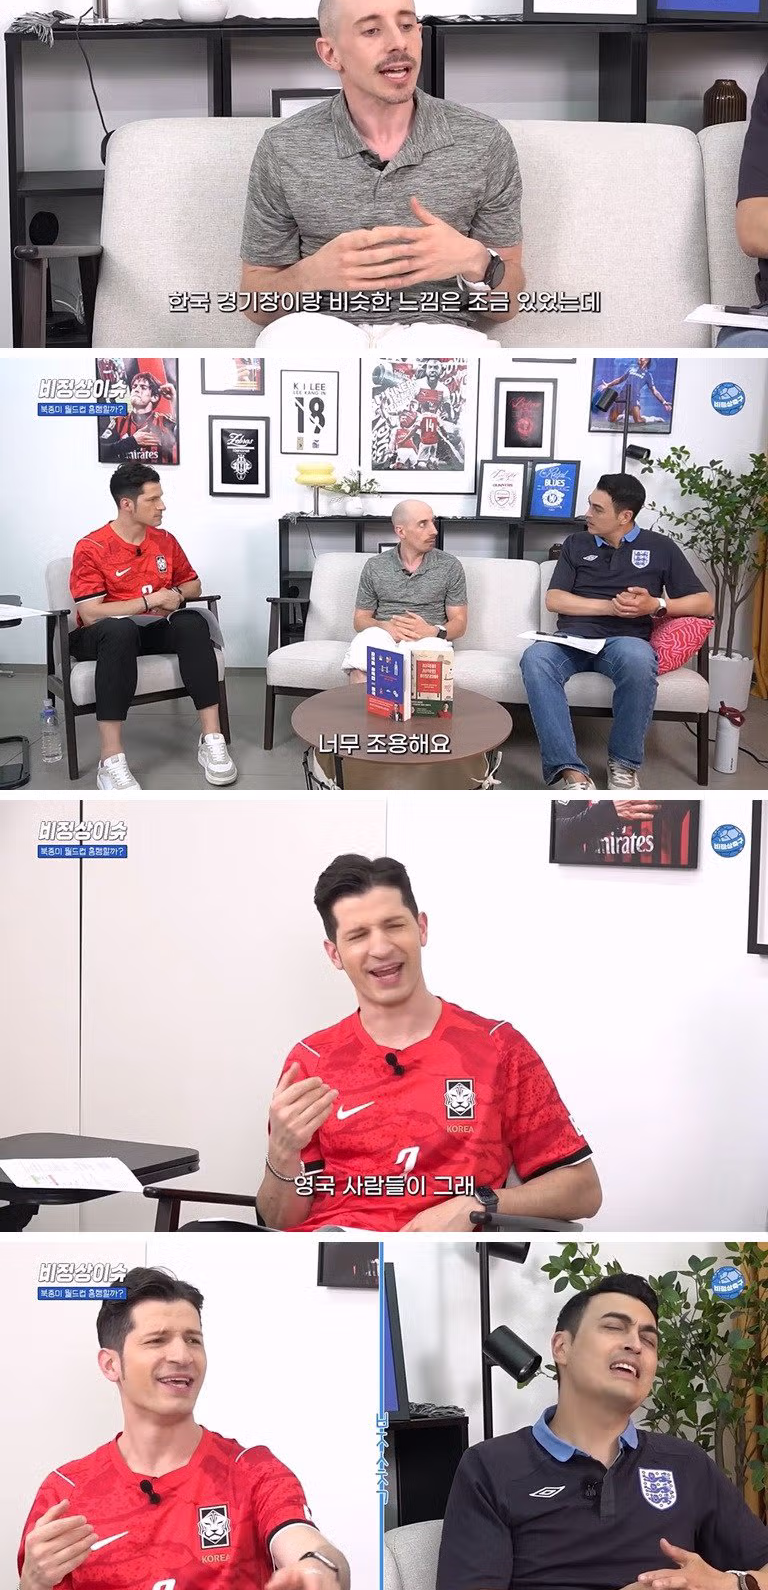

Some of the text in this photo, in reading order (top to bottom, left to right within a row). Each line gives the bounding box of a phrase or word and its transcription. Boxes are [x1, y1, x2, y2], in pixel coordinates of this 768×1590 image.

[425, 418, 435, 432] 14
[446, 1125, 475, 1133] KOREA
[201, 1553, 231, 1564] KOREA
